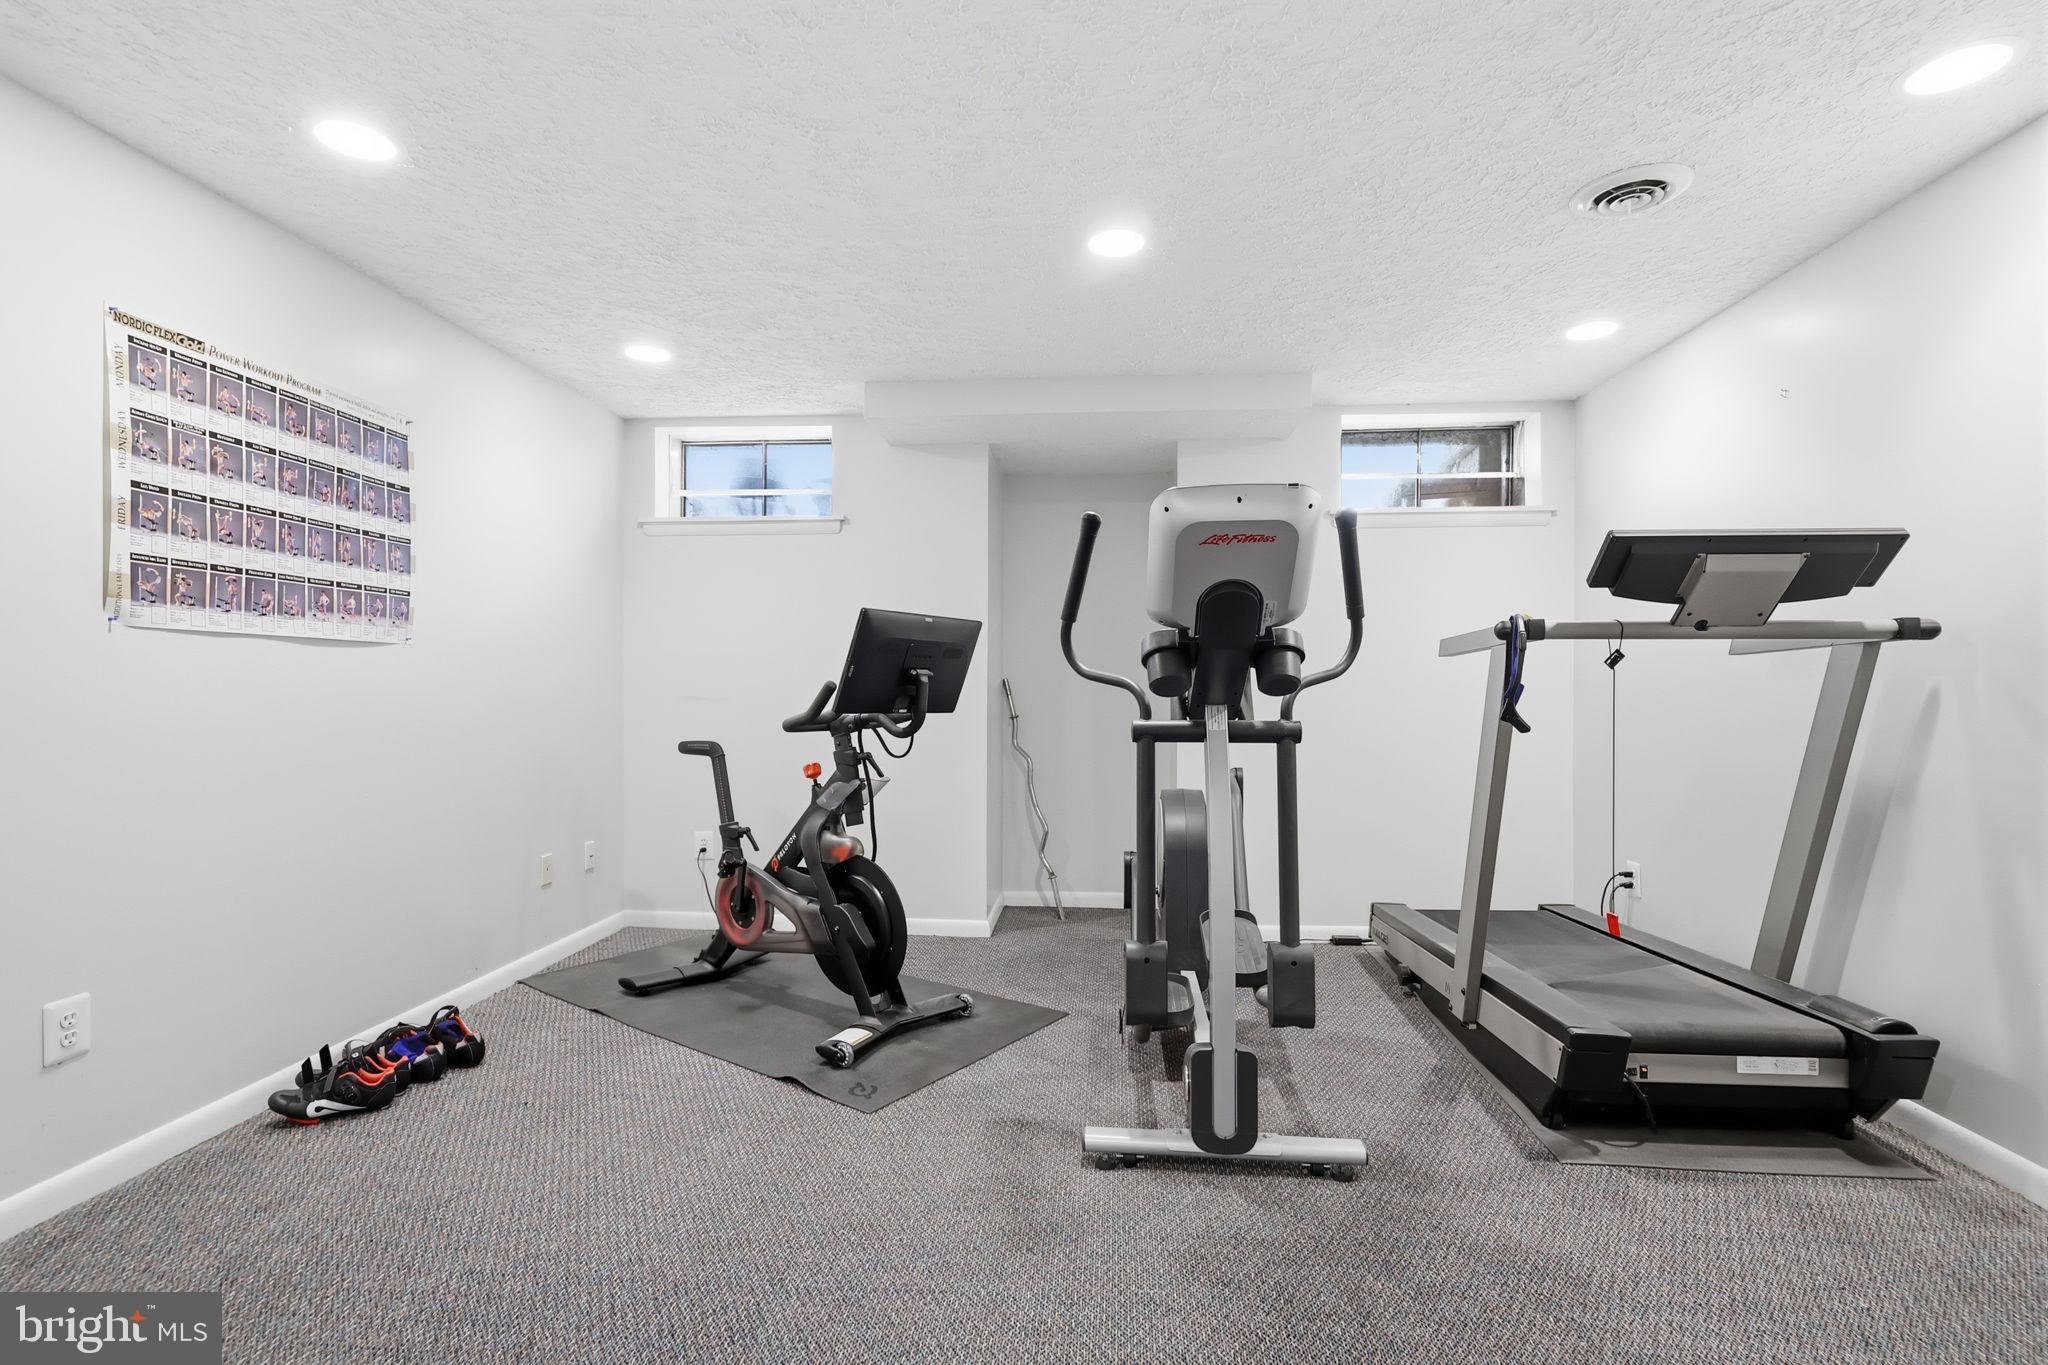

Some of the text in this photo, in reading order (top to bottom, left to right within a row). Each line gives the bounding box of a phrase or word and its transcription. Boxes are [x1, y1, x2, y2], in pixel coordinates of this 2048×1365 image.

[113, 310, 152, 335] NORDIC
[153, 325, 177, 343] FLEX
[177, 334, 206, 354] Gold
[209, 345, 240, 367] POWER
[243, 358, 284, 382] WORKOUT
[286, 374, 322, 396] PROGRAM
[114, 343, 124, 387] MONDAY
[117, 410, 127, 469] WEDNESDAY
[117, 496, 126, 531] FRIDAY
